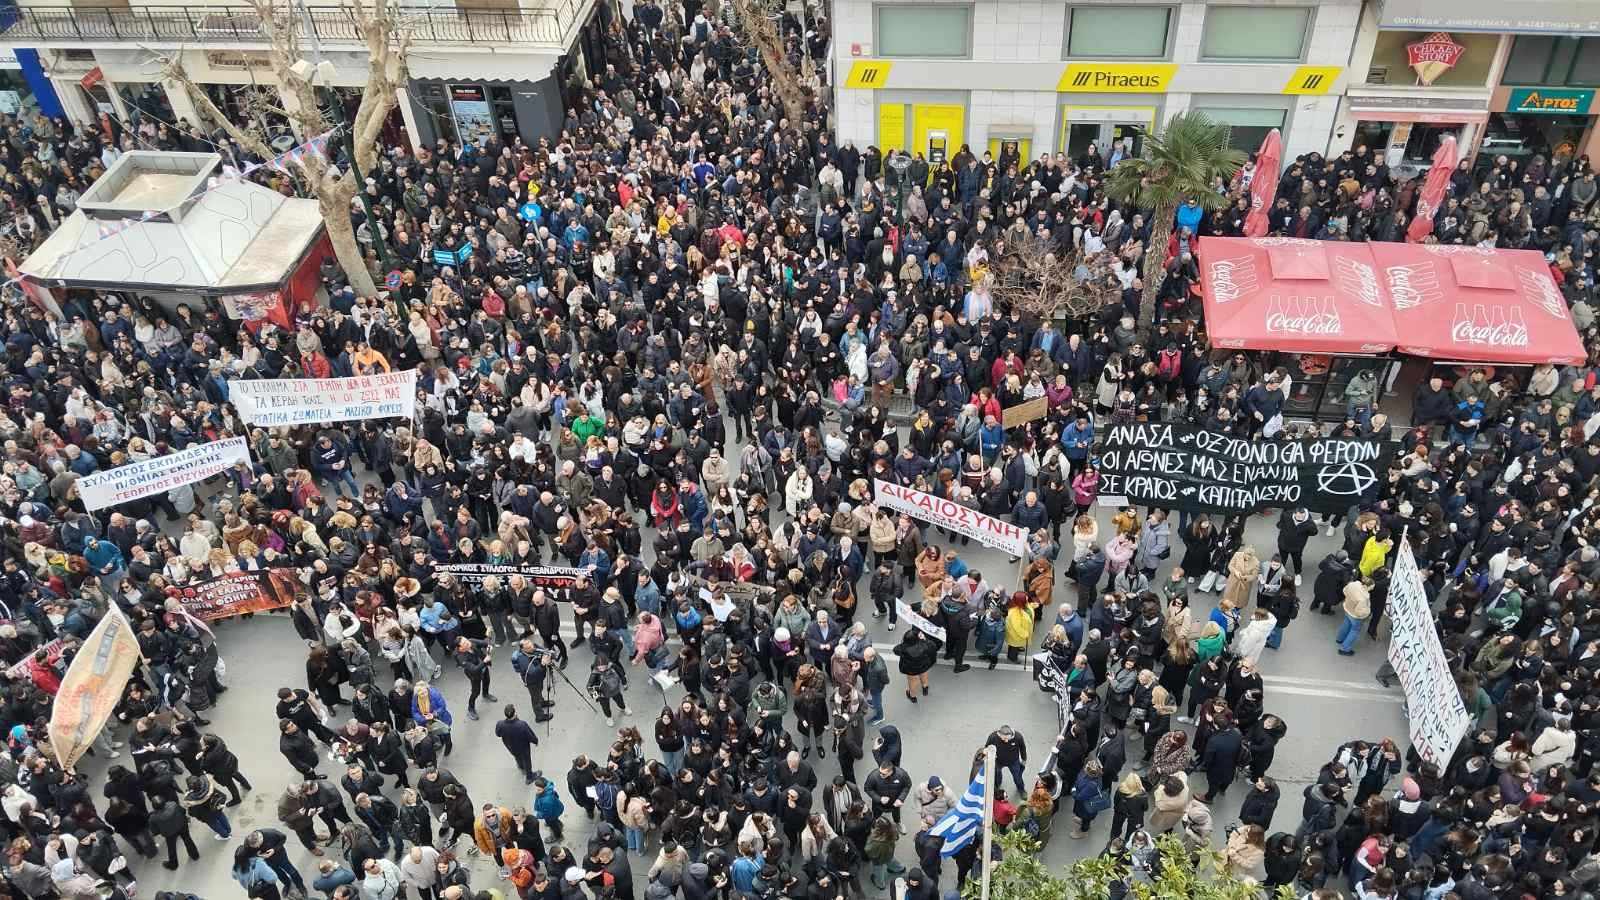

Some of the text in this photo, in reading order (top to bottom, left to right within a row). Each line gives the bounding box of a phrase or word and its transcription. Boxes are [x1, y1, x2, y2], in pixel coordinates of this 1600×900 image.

[1414, 44, 1458, 54] CHICKEN
[1418, 52, 1452, 62] STORY
[1095, 71, 1160, 87] Piraeus
[315, 380, 343, 393] ΤΕΜΠΗ
[255, 396, 267, 409] ΤΑ
[385, 386, 400, 399] ΜΑΣ
[1106, 424, 1174, 448] ΑΝΑΣΑ
[1196, 430, 1278, 464] ΟΞΥΓΟΝΟ
[1281, 442, 1304, 463] ΘΑ
[1309, 440, 1380, 464] ΦΕΡΟΥΝ
[83, 439, 243, 487] ΣΥΛΛΟΓΟΣ ΕΚΠΑΙΔΕΥΤΙΚΩΝ
[1102, 450, 1120, 470] ΟΙ
[1124, 450, 1188, 473] ΑΓΩΝΕΣ
[1191, 454, 1228, 482] ΜΑΣ
[1100, 474, 1121, 493] ΣΕ
[1124, 476, 1180, 500] ΚΡΑΤΟΣ
[881, 483, 1020, 539] ΔΙΚΑΙΟΣΥΝΗ
[480, 564, 518, 573] ΣΥΛΛΟΓΟΣ
[197, 575, 260, 593] ΦΕΒΡΟΥΑΡΙΟΥ
